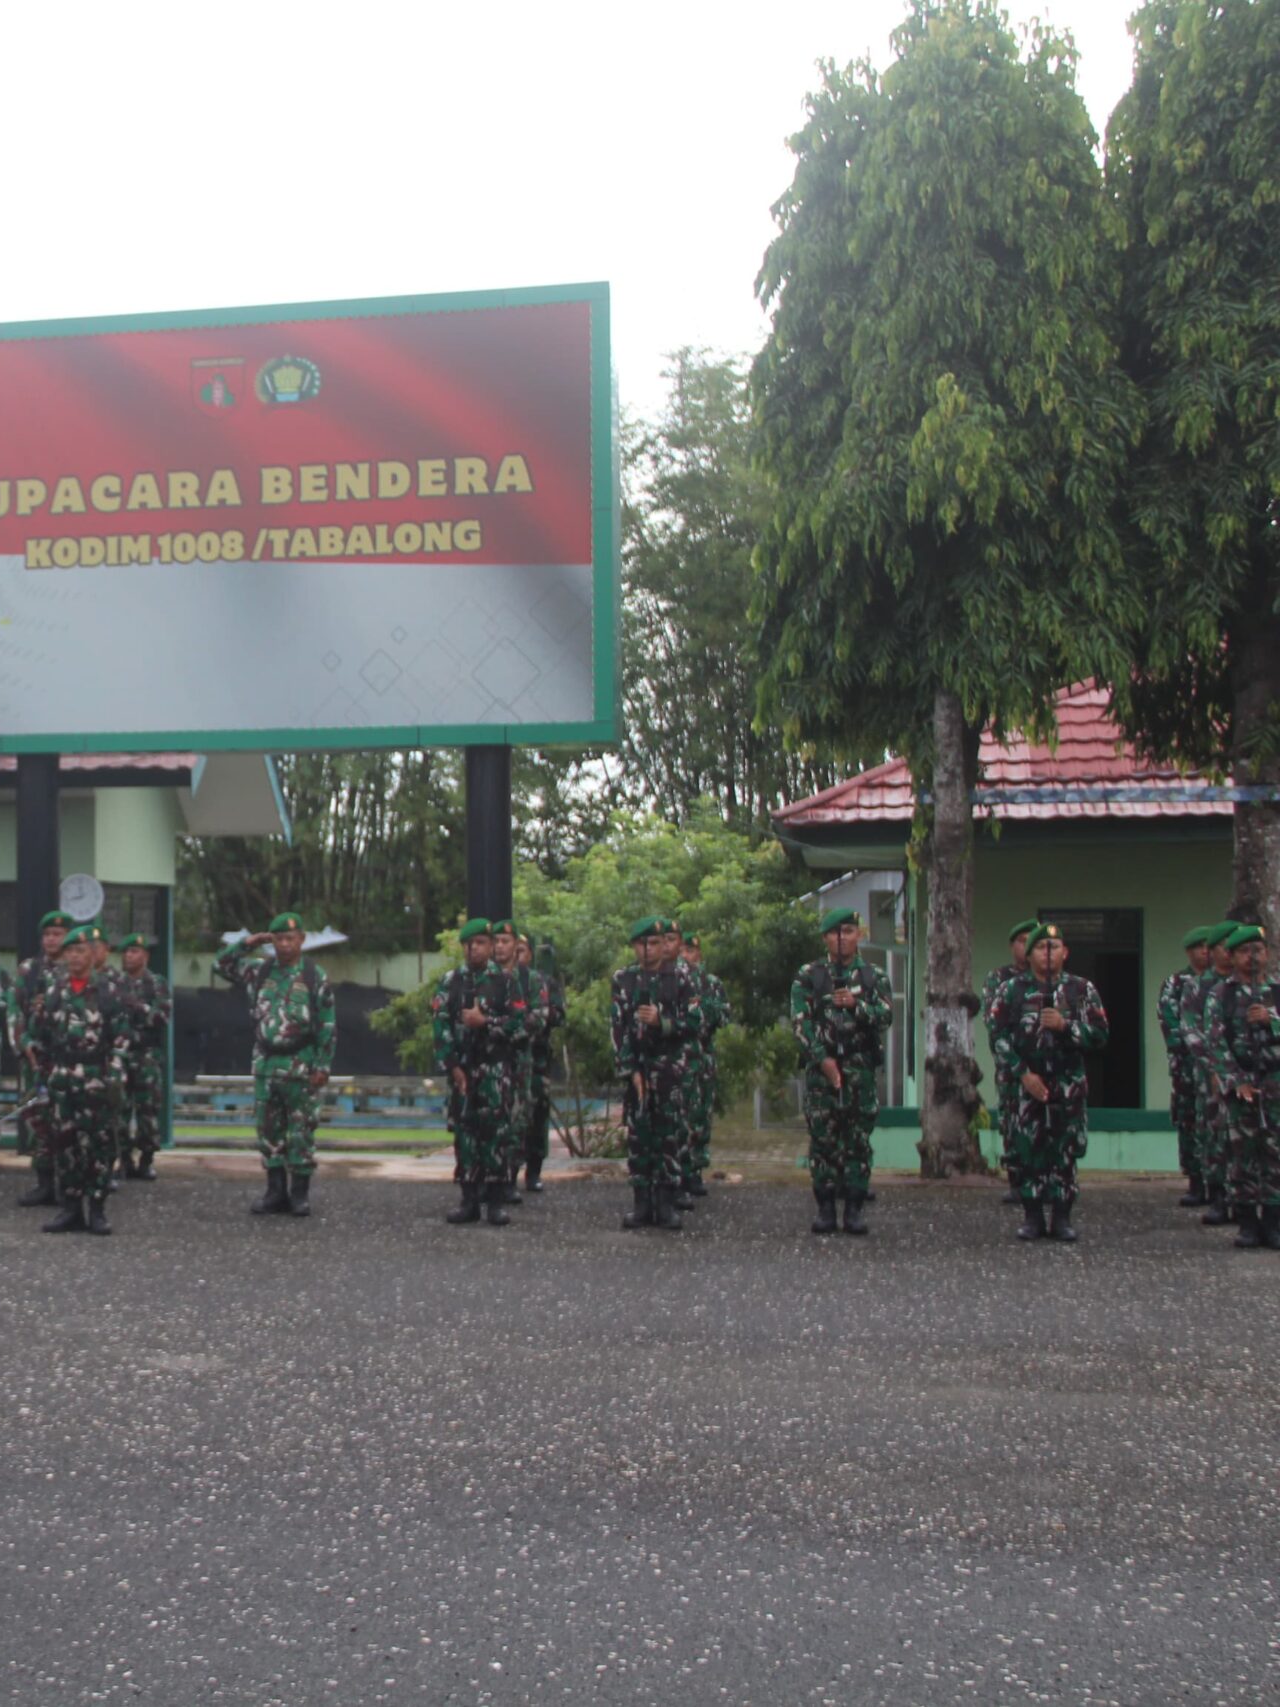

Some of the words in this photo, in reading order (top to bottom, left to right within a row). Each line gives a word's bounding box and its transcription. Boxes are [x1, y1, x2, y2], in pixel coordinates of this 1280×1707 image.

[260, 454, 534, 505] BENDERA
[24, 534, 152, 570] KODIM
[157, 530, 245, 563] 1008
